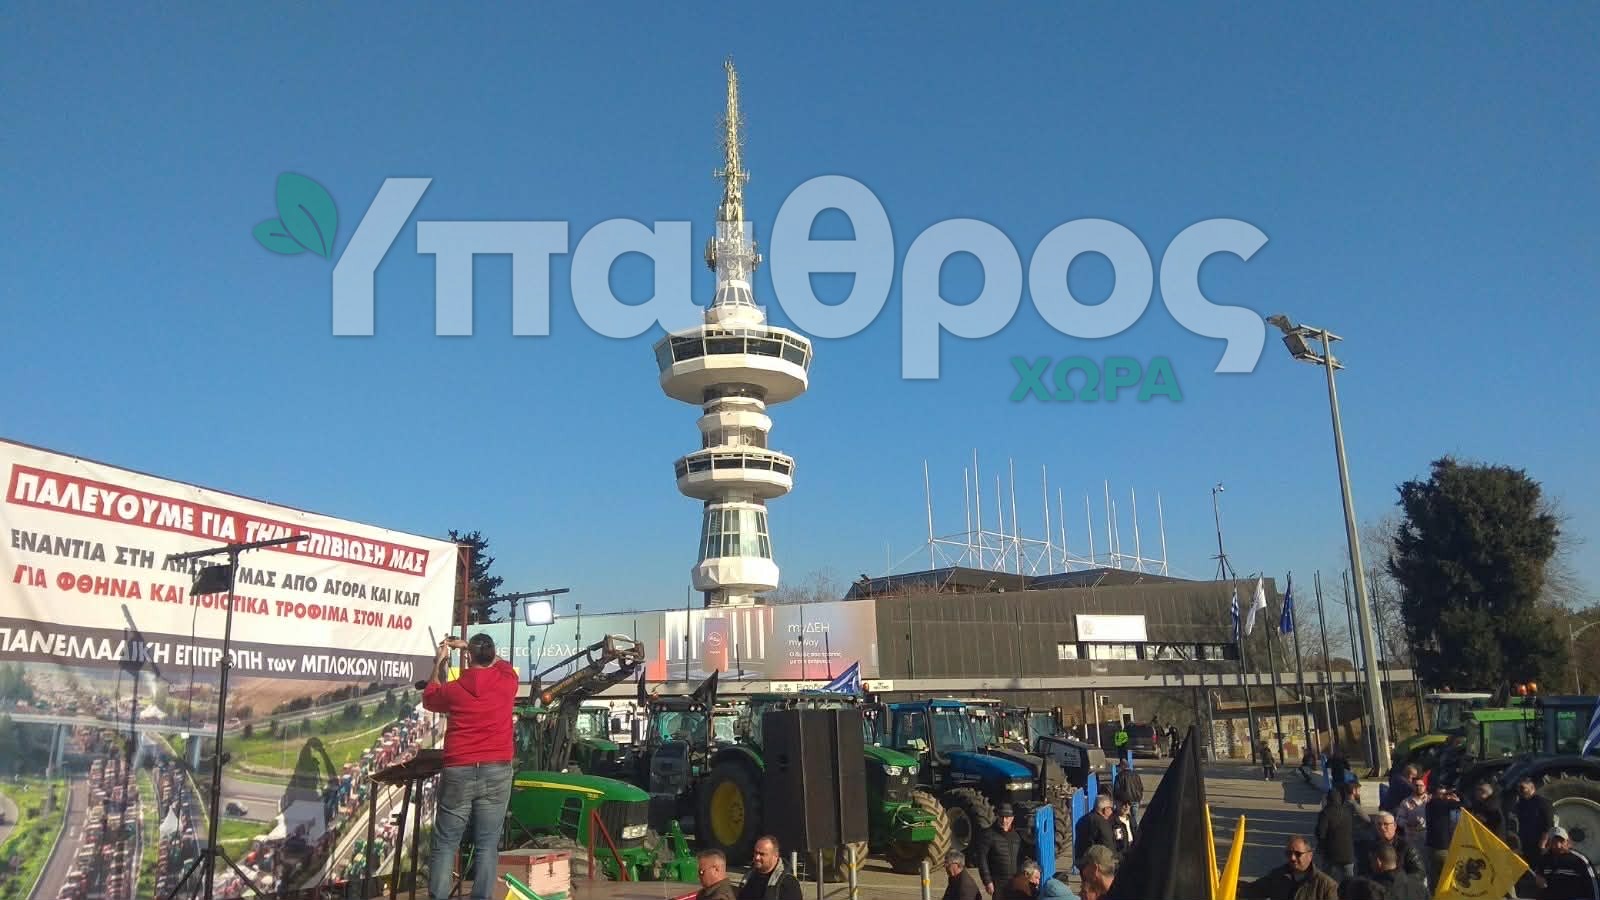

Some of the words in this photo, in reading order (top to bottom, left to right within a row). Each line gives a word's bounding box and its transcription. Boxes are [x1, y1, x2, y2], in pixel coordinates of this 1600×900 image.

[14, 471, 195, 532] ΠΑΛΕΥΟΥΜΕ
[201, 511, 237, 540] ΓΙΑ
[295, 530, 386, 566] ΕΠΙΒΙΩΣΗ
[389, 549, 426, 573] ΜΑΣ
[11, 528, 107, 563] ΕΝΑΝΤΙΑ
[114, 545, 156, 569] ΣΤΗ
[238, 567, 277, 588] ΜΑΣ
[281, 573, 318, 593] ΑΠΟ
[323, 578, 367, 600] ΑΓΟΡΑ
[370, 585, 392, 603] ΚΑΙ
[394, 589, 421, 607] ΚΑΠ
[12, 564, 48, 589] ΓΙΑ
[56, 571, 142, 600] ΦΘΗΝΑ
[150, 583, 185, 605] ΚΑΙ
[275, 600, 349, 624] ΤΡΟΦΙΜΑ
[353, 609, 384, 628] ΣΤΟΝ
[386, 614, 413, 631] ΛΑΟ
[266, 656, 297, 673] των
[300, 654, 378, 676] ΜΠΛΟΚΩΝ
[379, 659, 415, 683] (ΠΕΜ)
